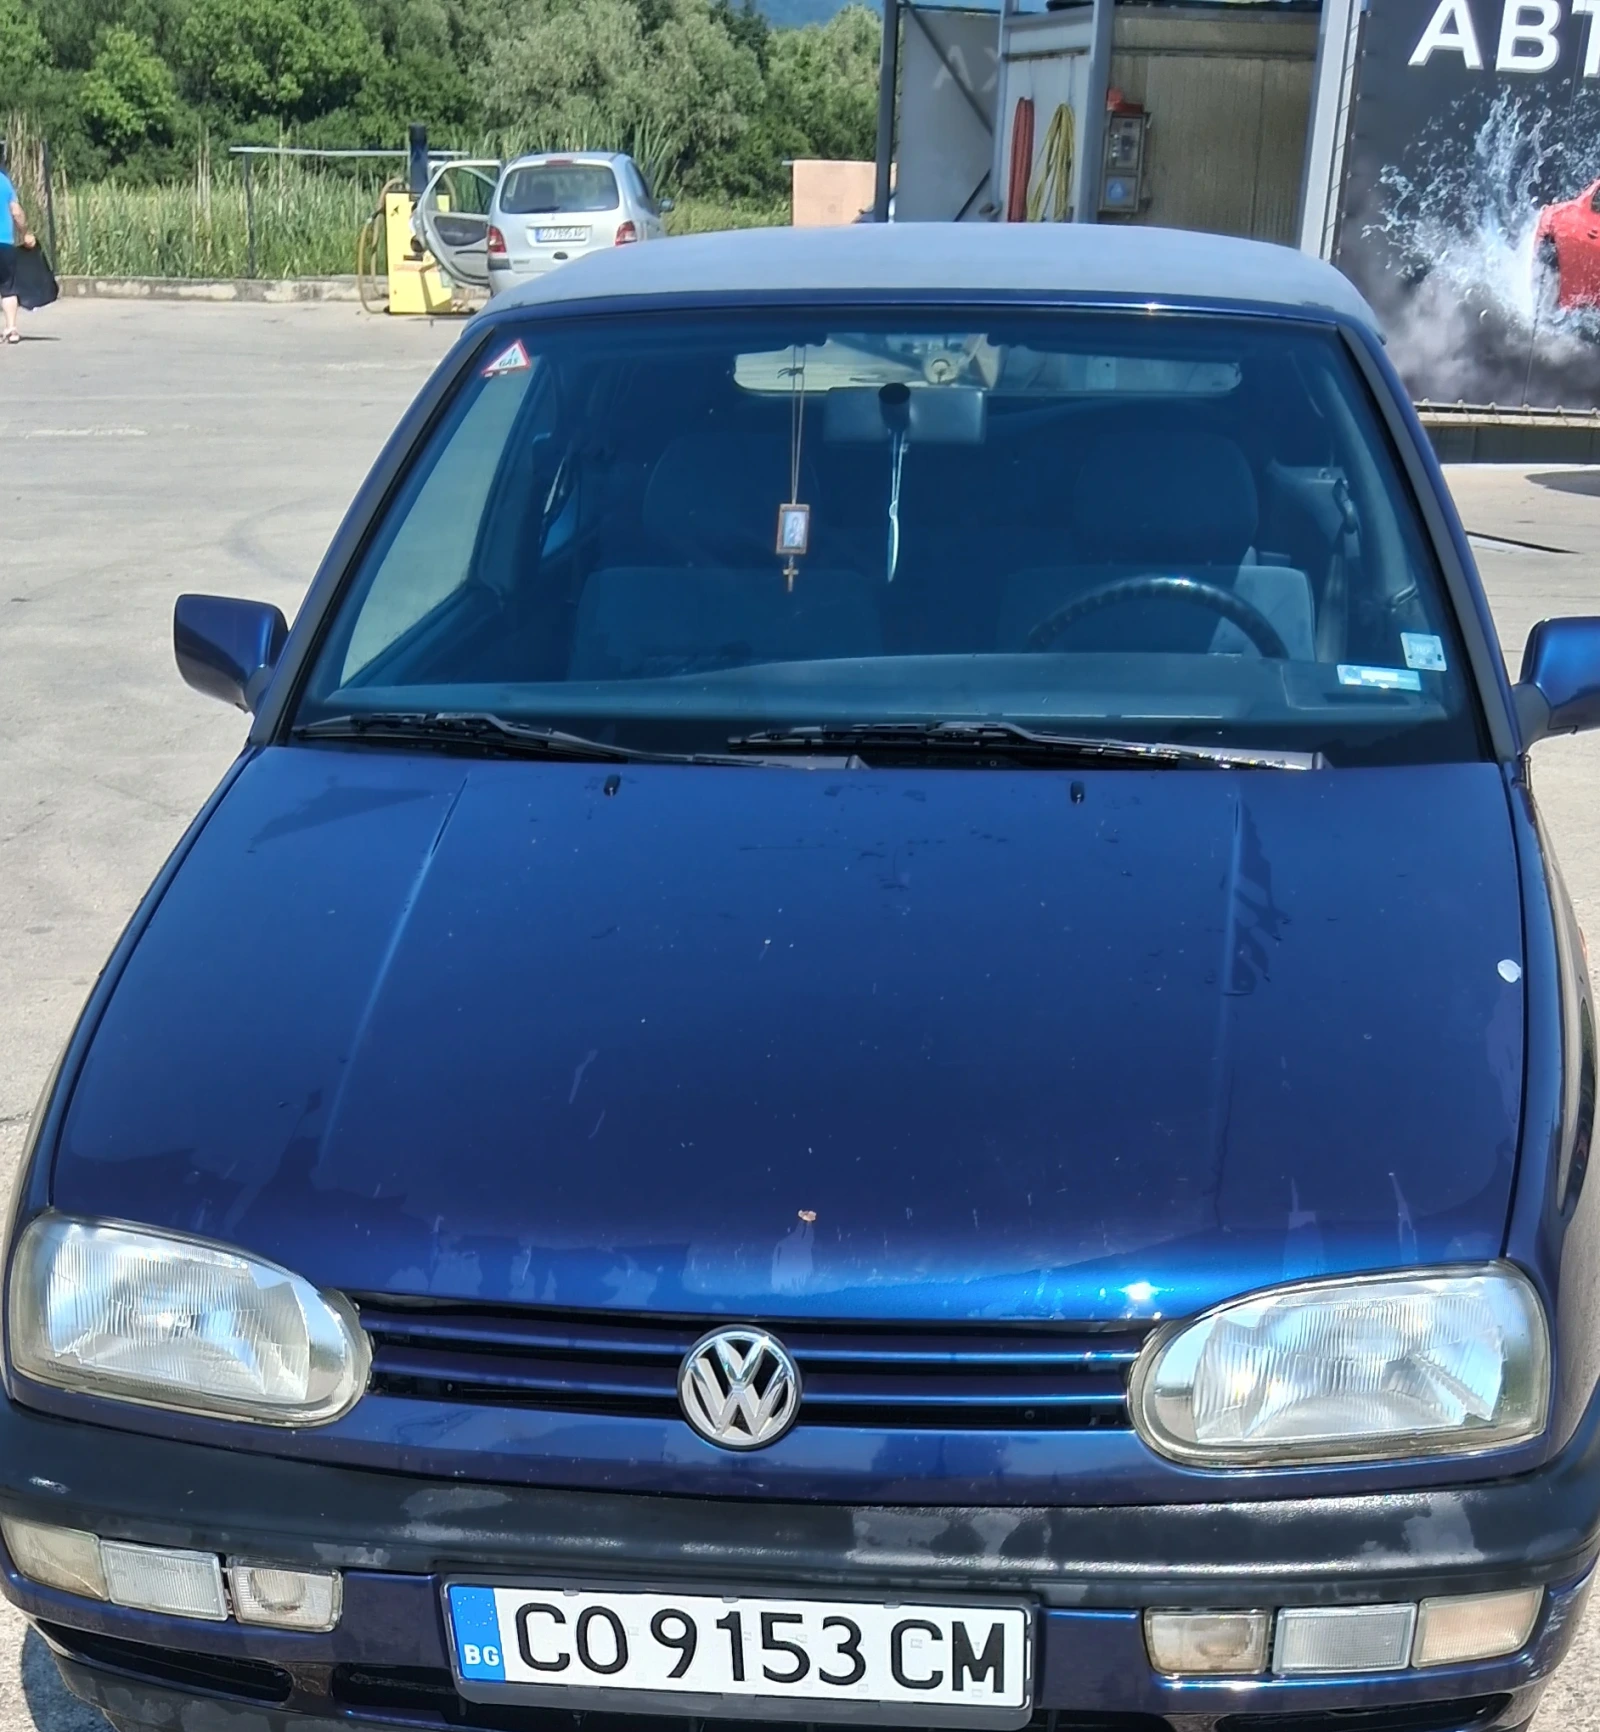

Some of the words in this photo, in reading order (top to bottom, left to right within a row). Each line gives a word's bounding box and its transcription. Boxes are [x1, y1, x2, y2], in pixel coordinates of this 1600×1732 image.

[682, 1331, 797, 1446] VW
[464, 1643, 500, 1667] BG
[515, 1602, 629, 1675] CO
[650, 1608, 867, 1687] 9153
[890, 1619, 1005, 1693] CM
